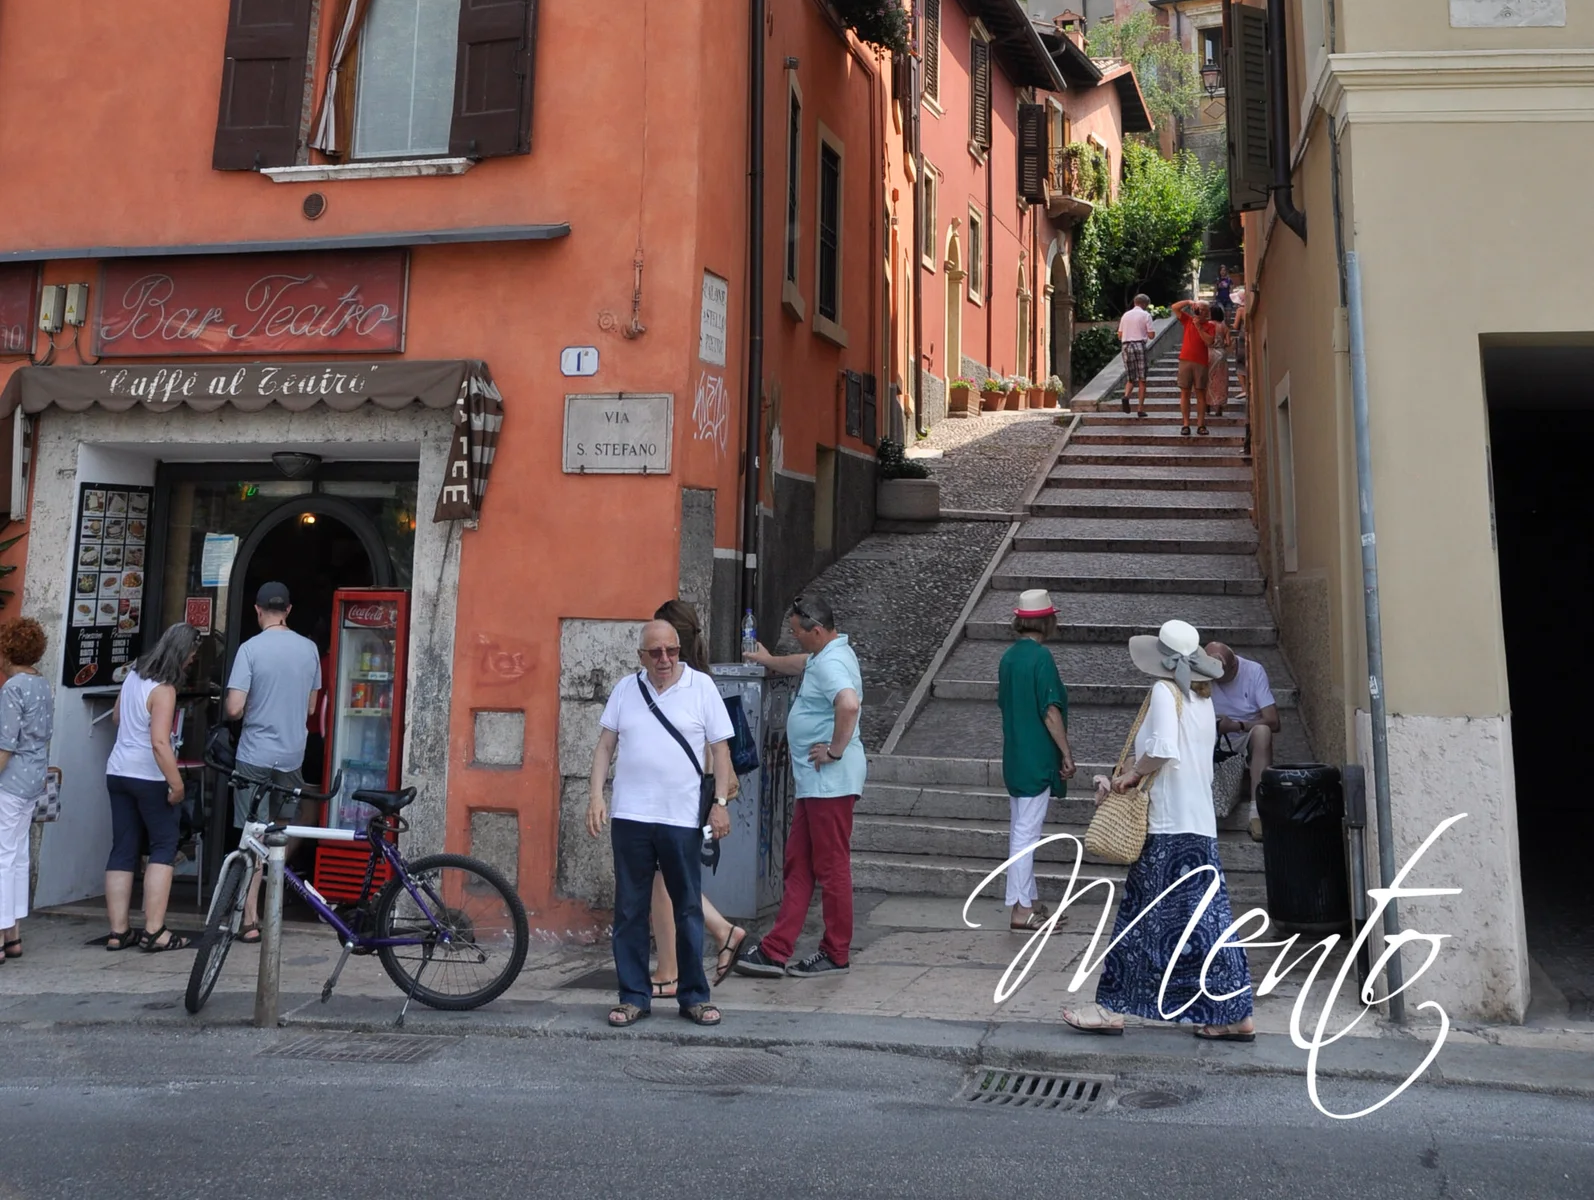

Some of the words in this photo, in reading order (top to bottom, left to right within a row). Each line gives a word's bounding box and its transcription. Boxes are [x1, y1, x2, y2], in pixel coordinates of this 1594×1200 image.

[101, 273, 225, 341] Bar
[227, 273, 398, 340] Teatro
[576, 350, 581, 372] 1
[206, 367, 247, 395] al
[604, 411, 631, 424] VIA
[576, 442, 588, 456] S.
[594, 442, 658, 456] STEFANO
